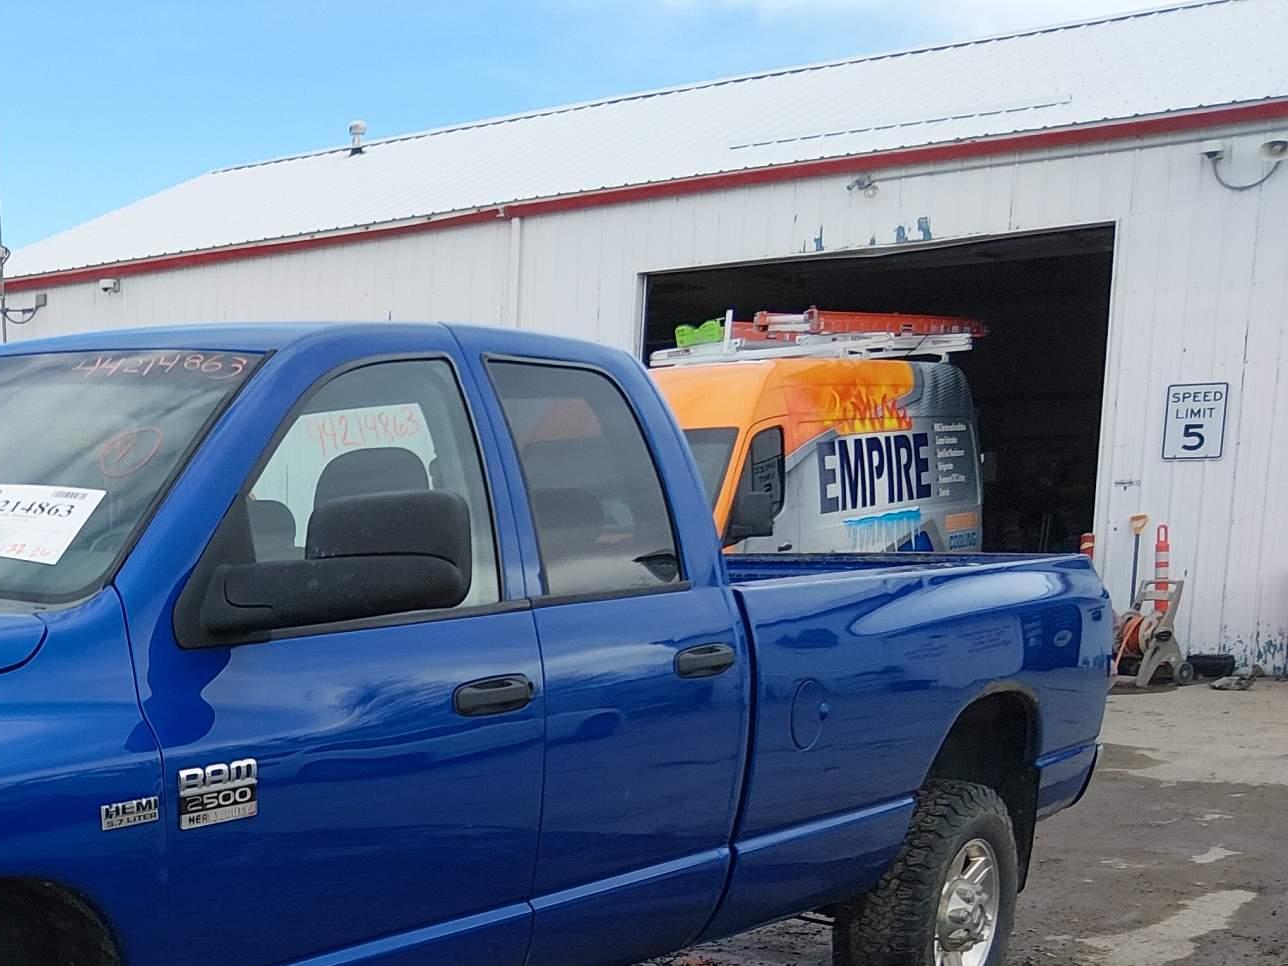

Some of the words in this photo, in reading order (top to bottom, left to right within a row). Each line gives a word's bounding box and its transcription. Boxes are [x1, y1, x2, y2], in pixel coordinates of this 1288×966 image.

[72, 354, 248, 380] 44214863
[1171, 390, 1224, 404] SPEED
[1175, 407, 1216, 419] LIMIT
[306, 405, 421, 457] 44214863
[1181, 423, 1205, 451] 5
[816, 432, 932, 515] EMPIRE
[177, 758, 257, 792] RAM
[104, 798, 158, 820] HEMI
[186, 787, 252, 811] 2500
[106, 817, 124, 829] 5.7
[126, 812, 157, 824] LITER
